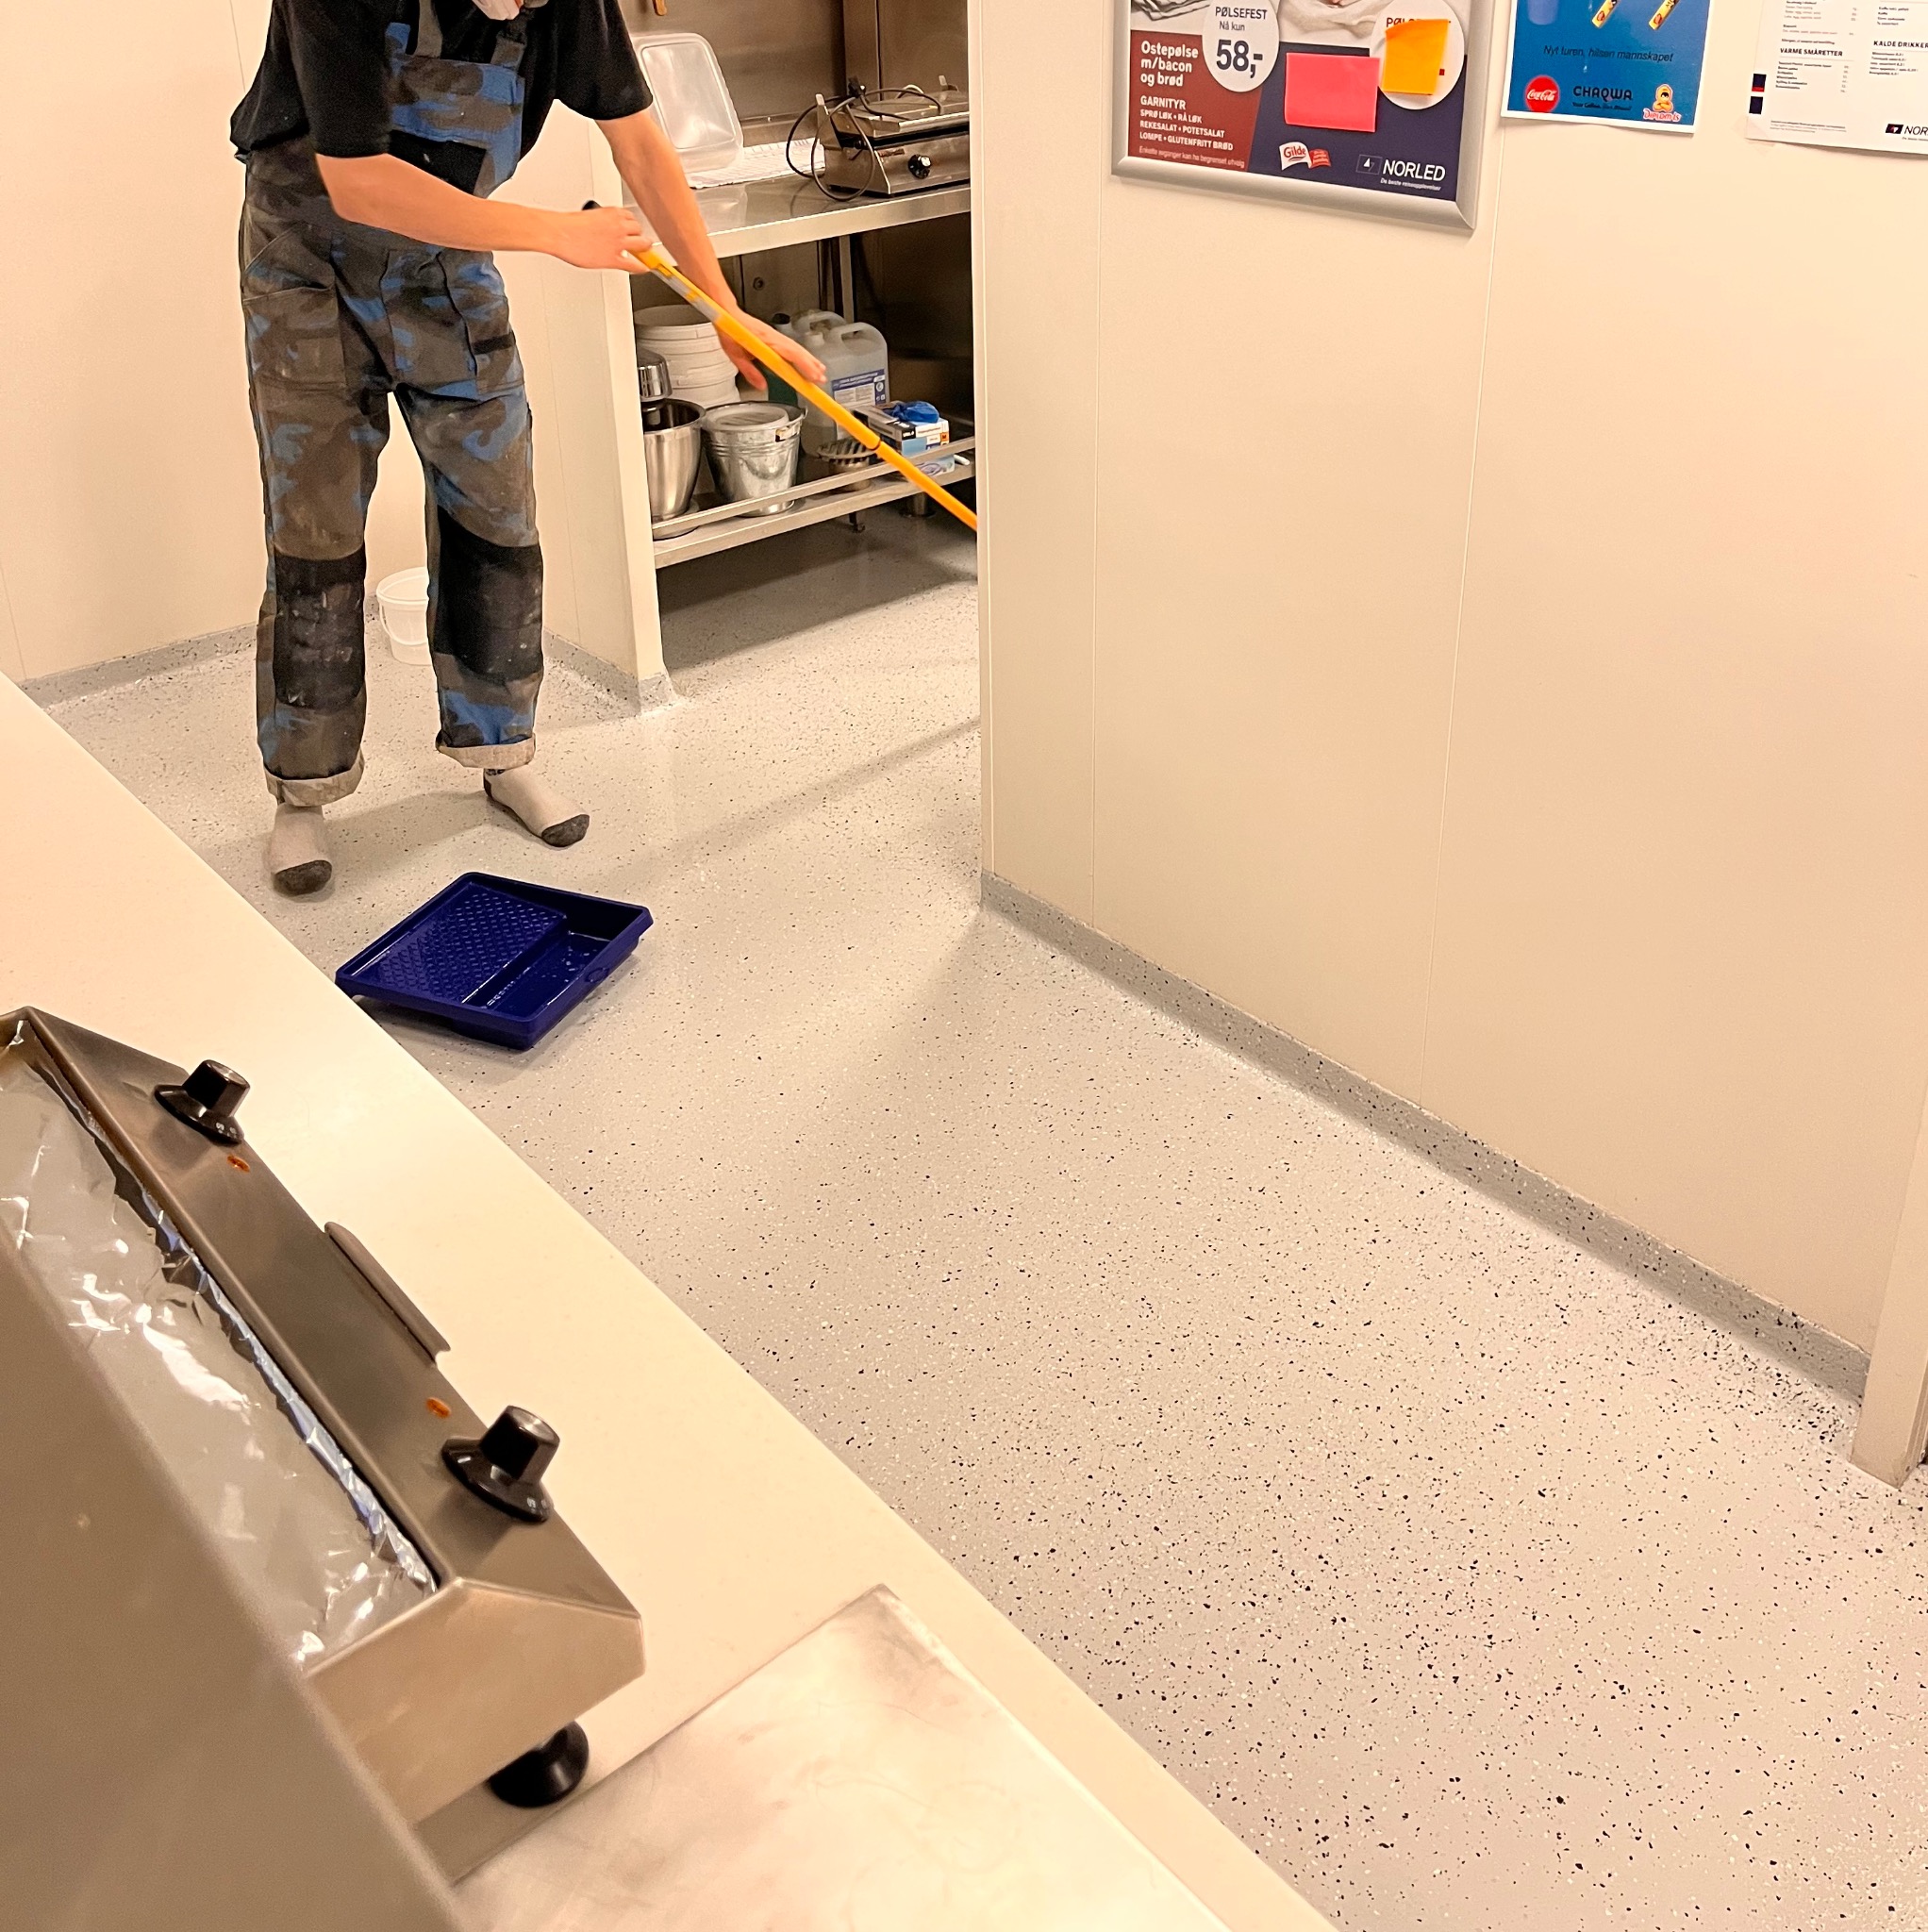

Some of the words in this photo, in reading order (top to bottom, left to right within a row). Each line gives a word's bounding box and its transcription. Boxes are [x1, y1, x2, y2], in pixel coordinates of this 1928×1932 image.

[1215, 7, 1268, 20] PØLSEFEST
[1219, 21, 1230, 30] Nå
[1231, 21, 1246, 31] kun
[1140, 41, 1199, 58] Ostepølse
[1543, 45, 1558, 56] Nyt
[1588, 48, 1615, 59] hilsen
[1617, 50, 1674, 63] mannskapet
[1803, 48, 1843, 57] SMÅRETTER
[1140, 57, 1193, 73] m/bacon
[1140, 73, 1155, 87] og
[1157, 72, 1184, 87] brød
[1572, 86, 1633, 102] CHAQWA
[1140, 95, 1186, 109] GARNITYR
[1140, 109, 1158, 118] SPRØ
[1158, 111, 1172, 120] LØK
[1178, 112, 1188, 122] RÅ
[1188, 115, 1203, 124] LØK
[1139, 120, 1177, 132] REKESALAT
[1182, 125, 1225, 138] POTETSALAT
[1139, 131, 1163, 142] LOMPE
[1167, 135, 1212, 148] GLUTENFRITT
[1213, 141, 1234, 151] BRØD
[1284, 146, 1306, 158] Gilde
[1382, 158, 1446, 182] NORLED
